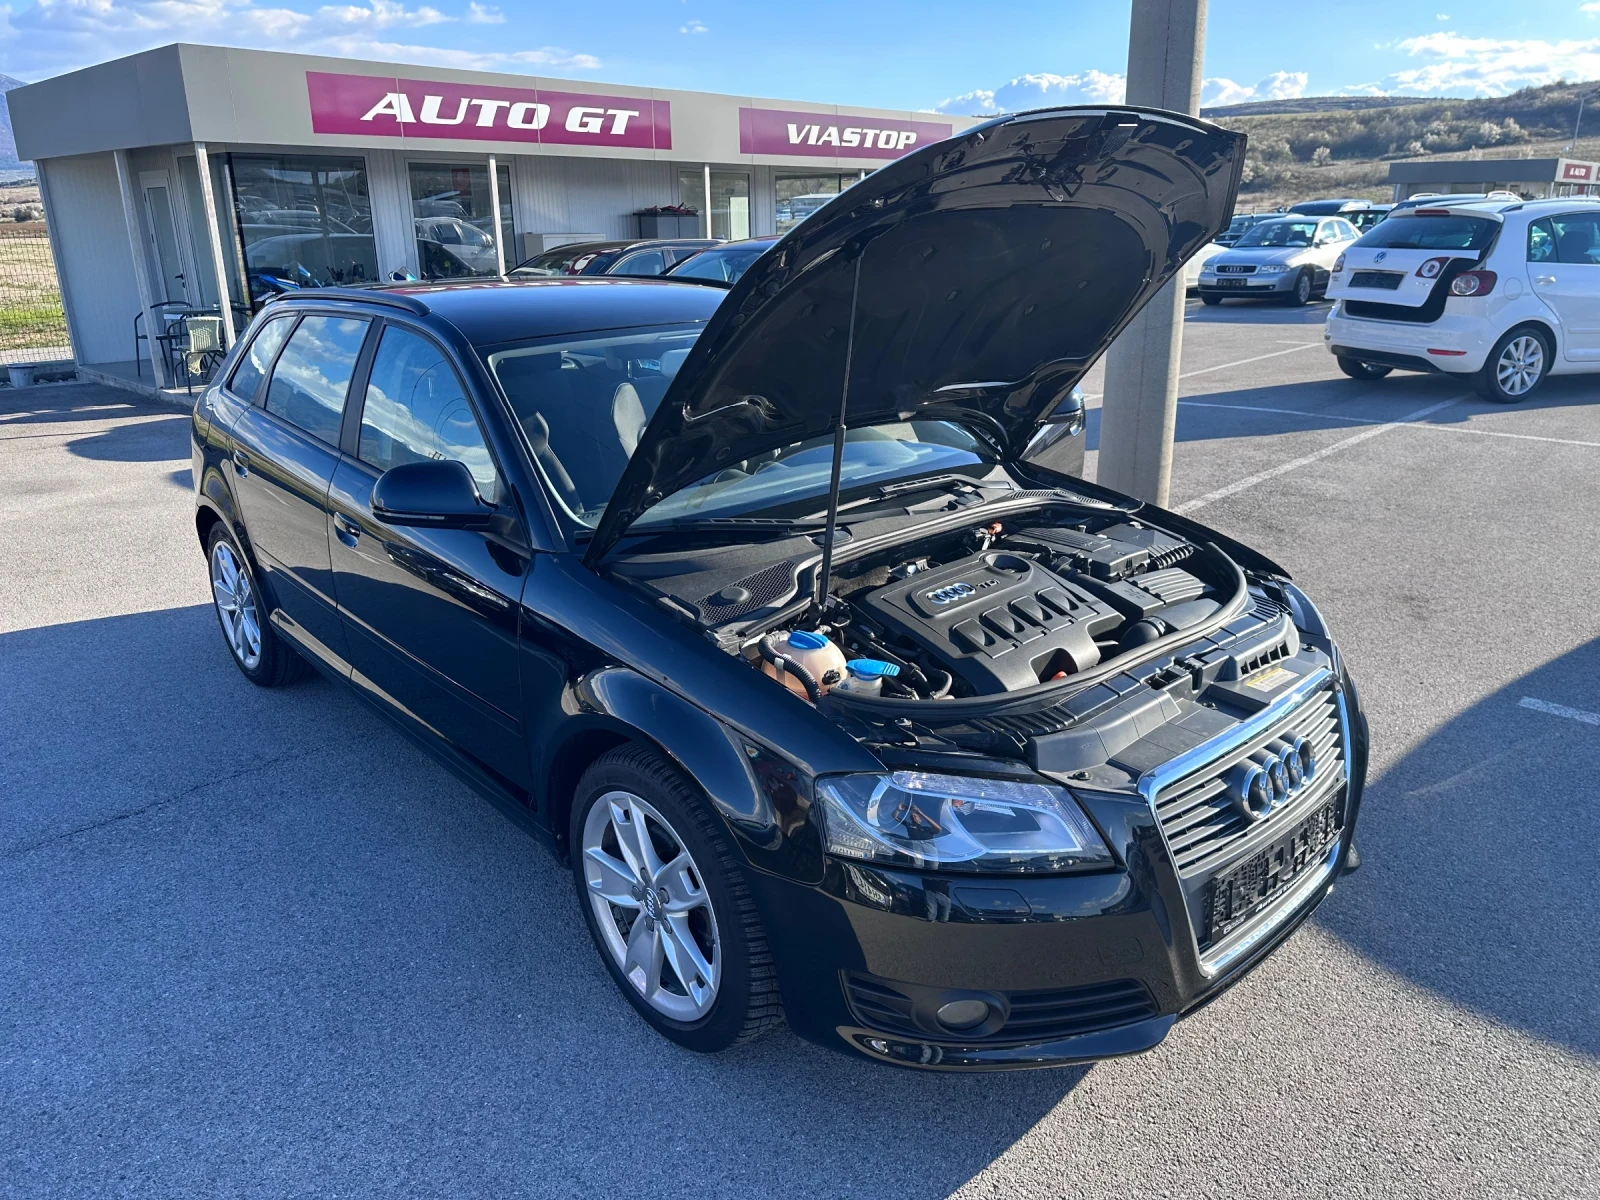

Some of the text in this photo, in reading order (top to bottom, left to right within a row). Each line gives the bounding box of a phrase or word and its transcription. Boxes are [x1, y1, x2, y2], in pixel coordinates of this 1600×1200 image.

[360, 92, 640, 135] AUTO GT
[787, 123, 917, 150] VIASTOP
